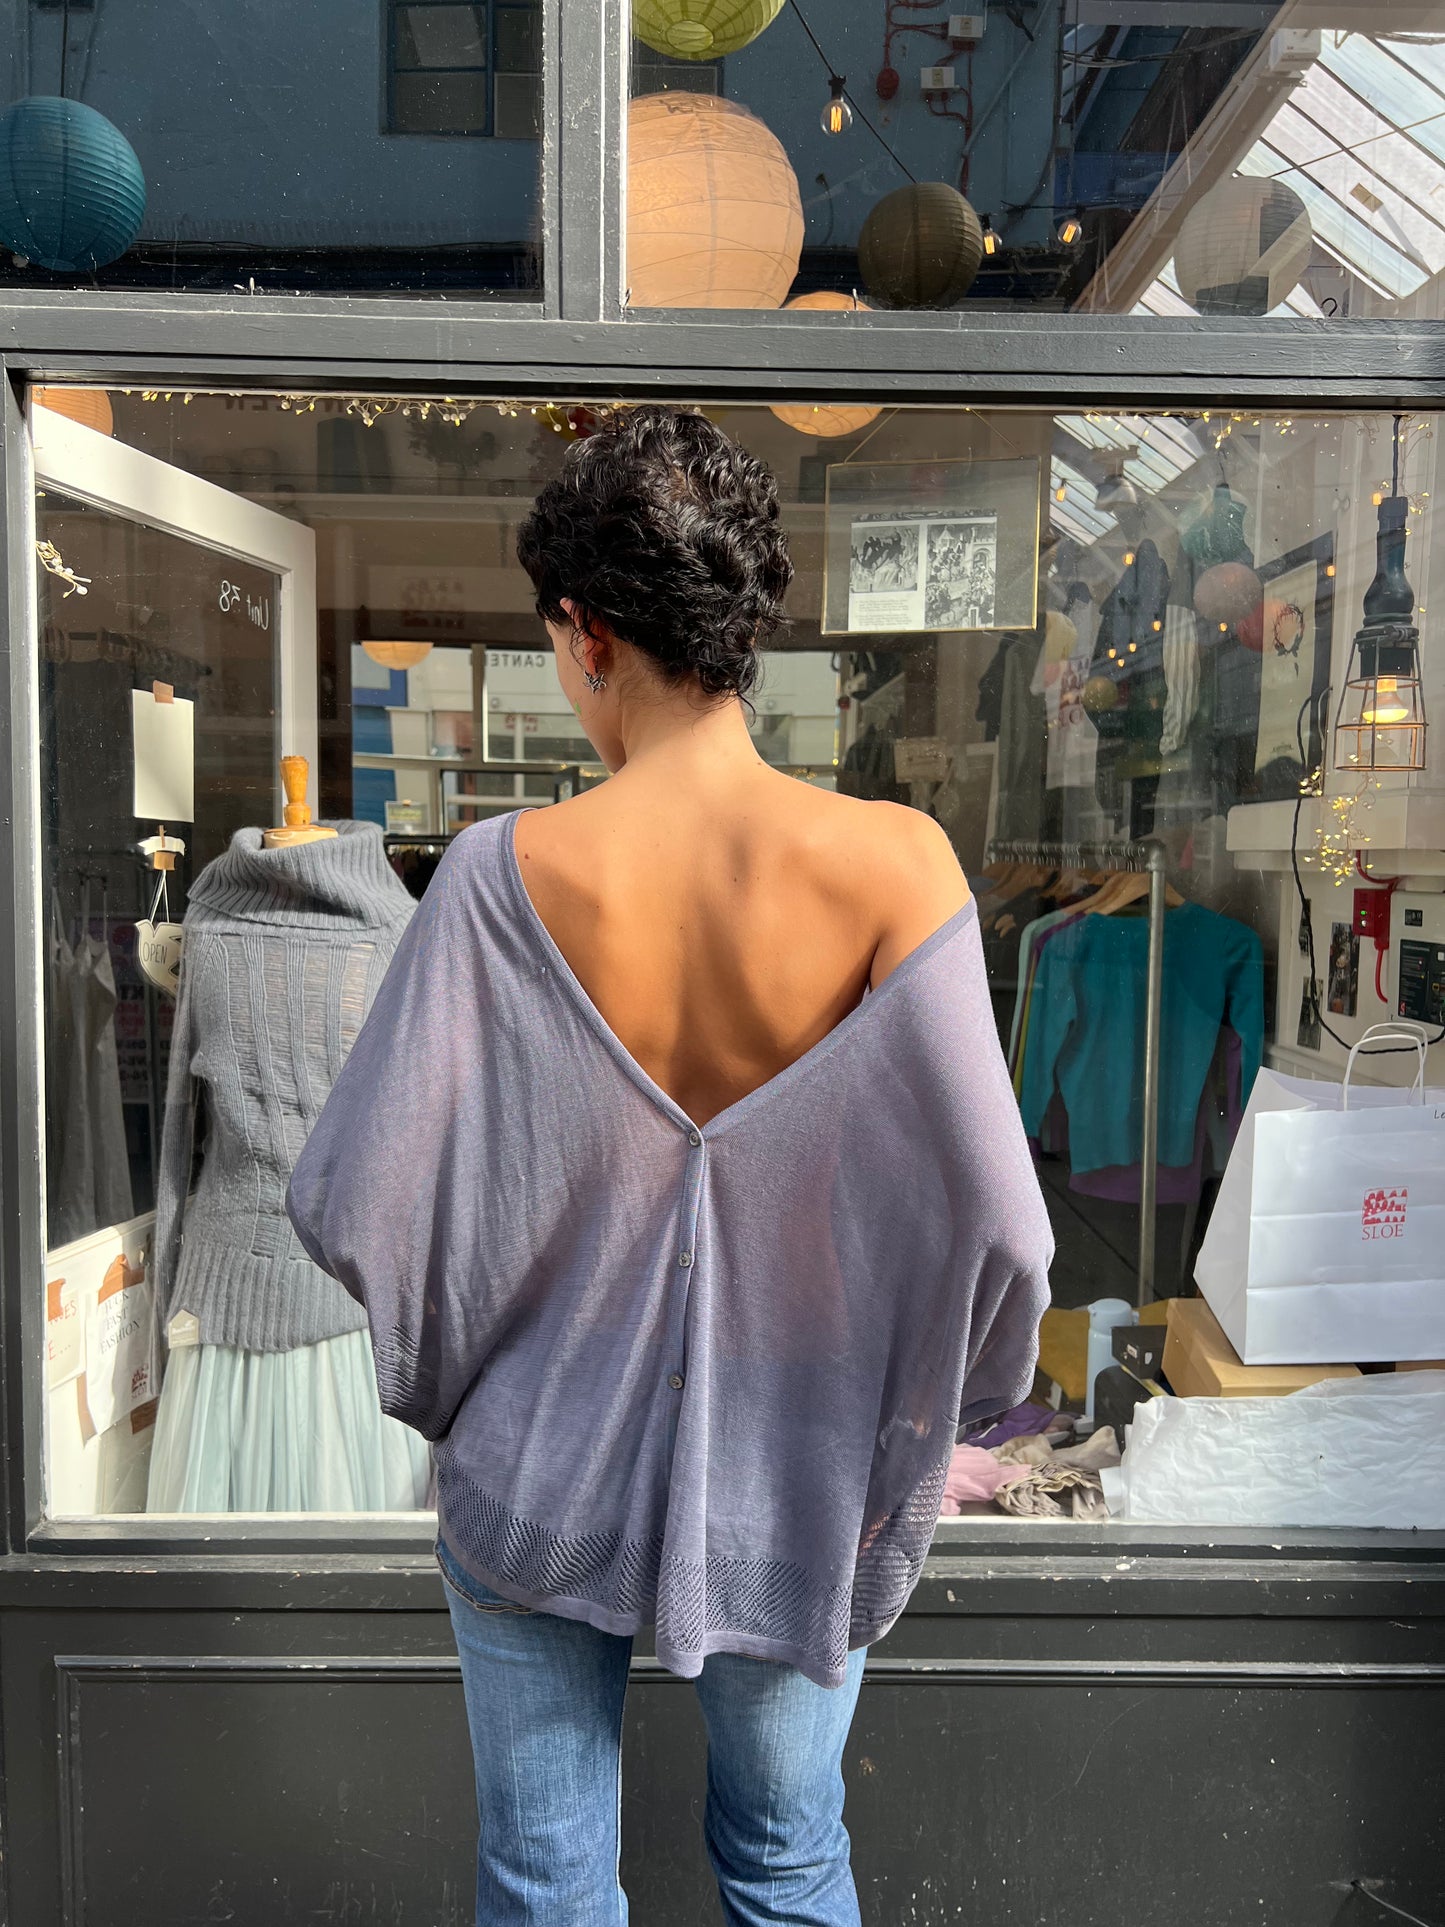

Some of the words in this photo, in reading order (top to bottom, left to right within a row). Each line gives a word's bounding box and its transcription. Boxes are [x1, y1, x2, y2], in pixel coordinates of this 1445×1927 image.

[142, 941, 168, 965] OPEN
[1361, 1223, 1404, 1241] SLOE
[104, 1308, 129, 1331] FAST
[99, 1319, 141, 1356] FASHION
